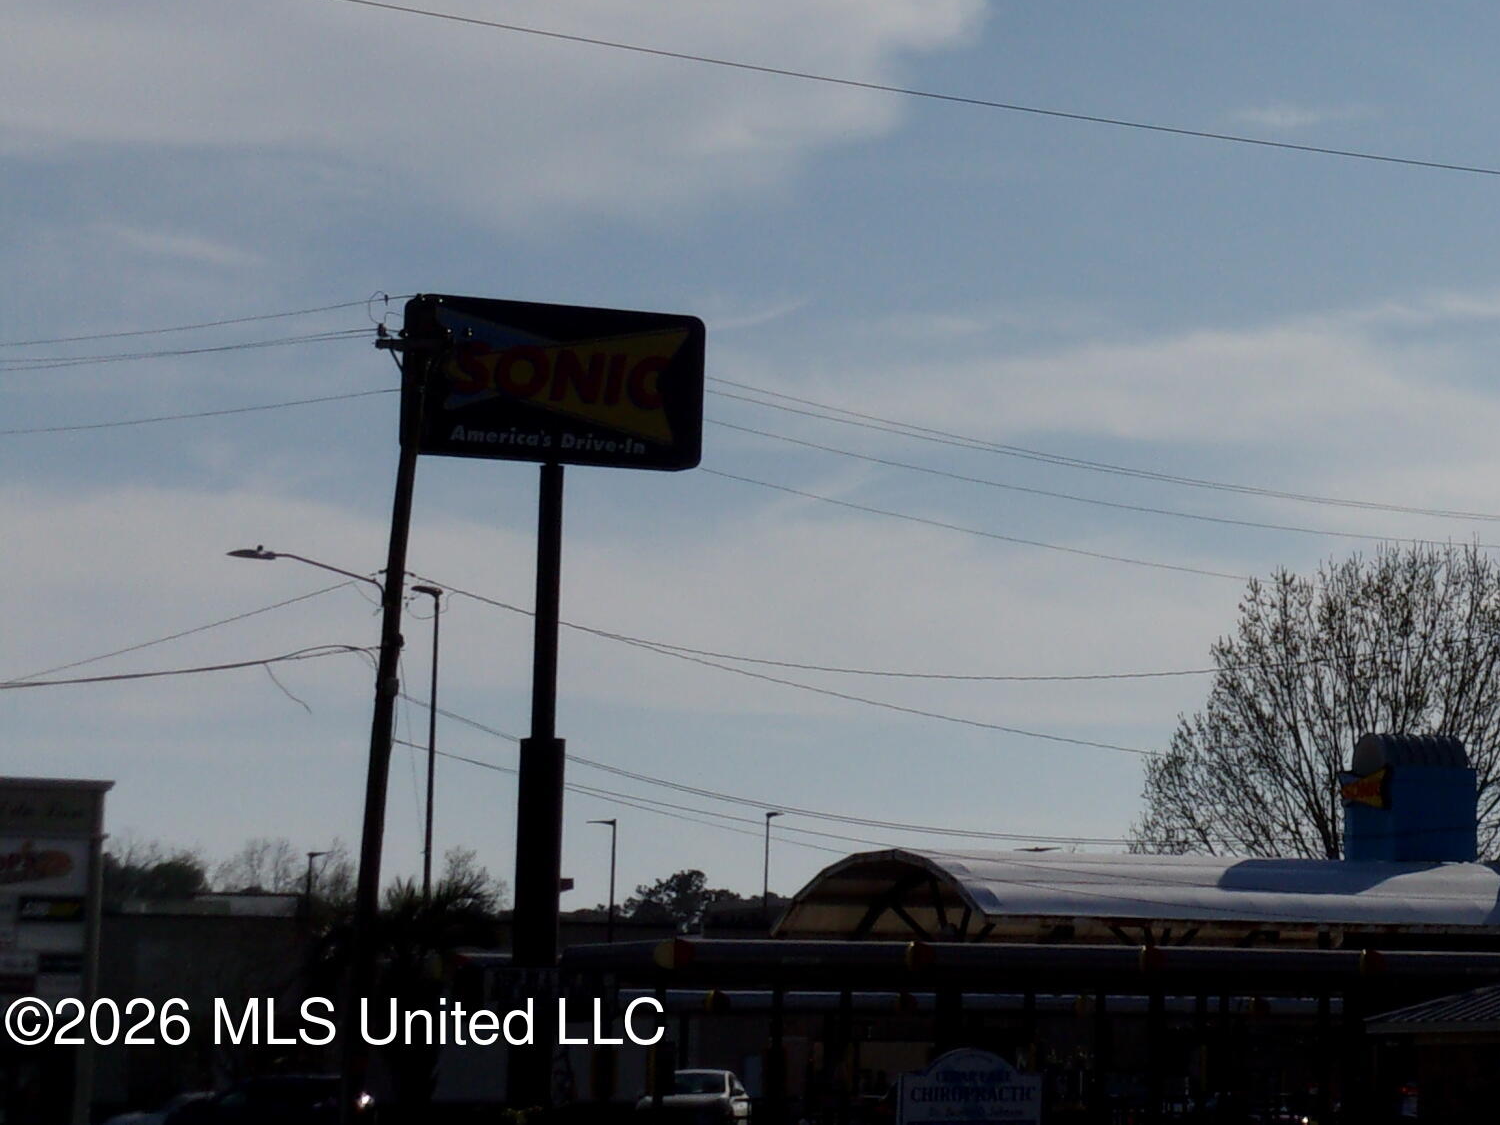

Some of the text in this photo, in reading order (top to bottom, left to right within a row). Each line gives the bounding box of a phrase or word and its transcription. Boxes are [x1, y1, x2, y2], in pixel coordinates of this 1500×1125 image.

[450, 341, 673, 410] SONIC
[449, 424, 647, 456] America's Drive-In
[910, 1085, 1037, 1102] CHIROPRACTIC
